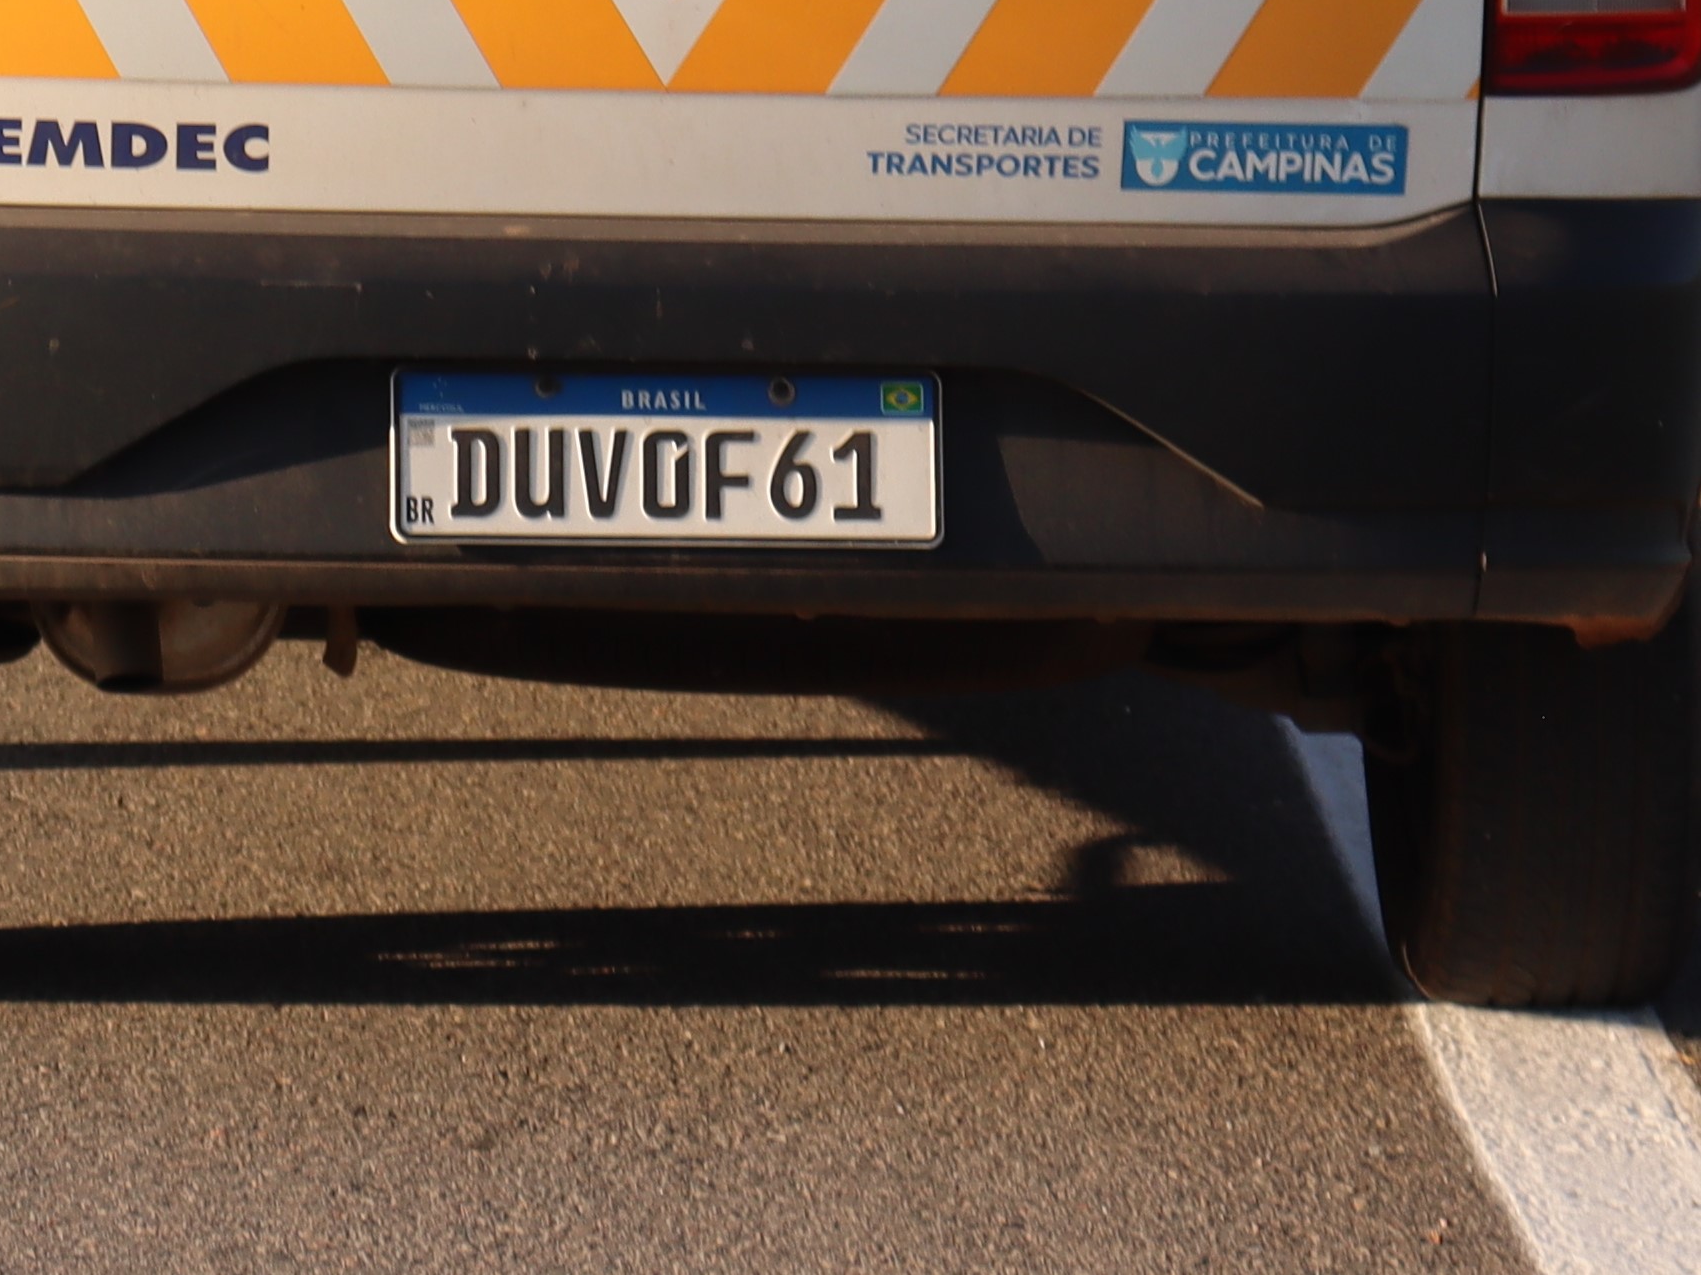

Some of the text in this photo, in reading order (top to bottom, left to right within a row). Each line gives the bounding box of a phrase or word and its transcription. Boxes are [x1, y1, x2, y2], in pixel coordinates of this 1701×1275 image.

[905, 124, 1102, 147] SECRETARIA DE
[1189, 131, 1397, 152] PREFEITURA DE
[867, 151, 1100, 179] TRANSPORTES
[1189, 150, 1395, 184] CAMPINAS
[621, 388, 707, 412] BRASIL
[405, 496, 435, 525] BR
